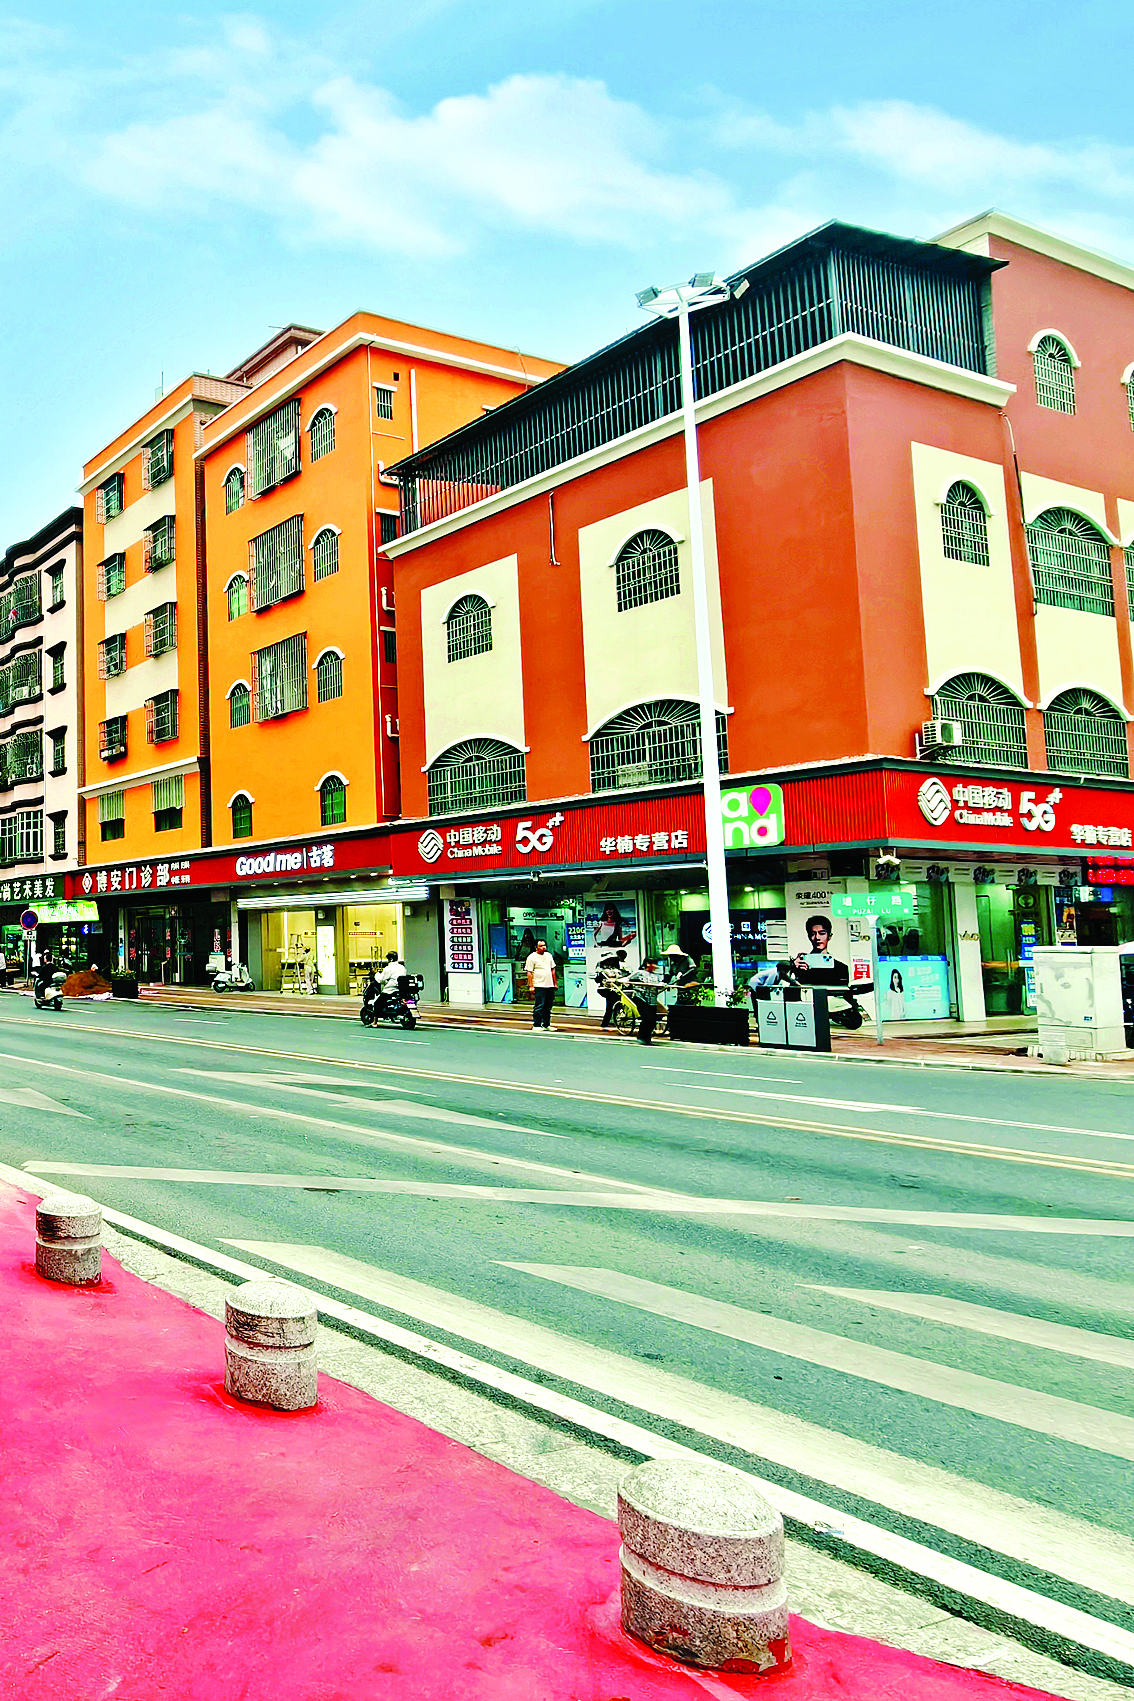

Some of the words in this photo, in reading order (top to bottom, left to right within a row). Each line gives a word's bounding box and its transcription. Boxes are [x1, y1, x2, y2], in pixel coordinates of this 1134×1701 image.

[952, 784, 1013, 810] 中国移动
[446, 824, 502, 846] 中国移动
[307, 844, 335, 868] 古茗
[96, 863, 170, 892] 博安门诊部
